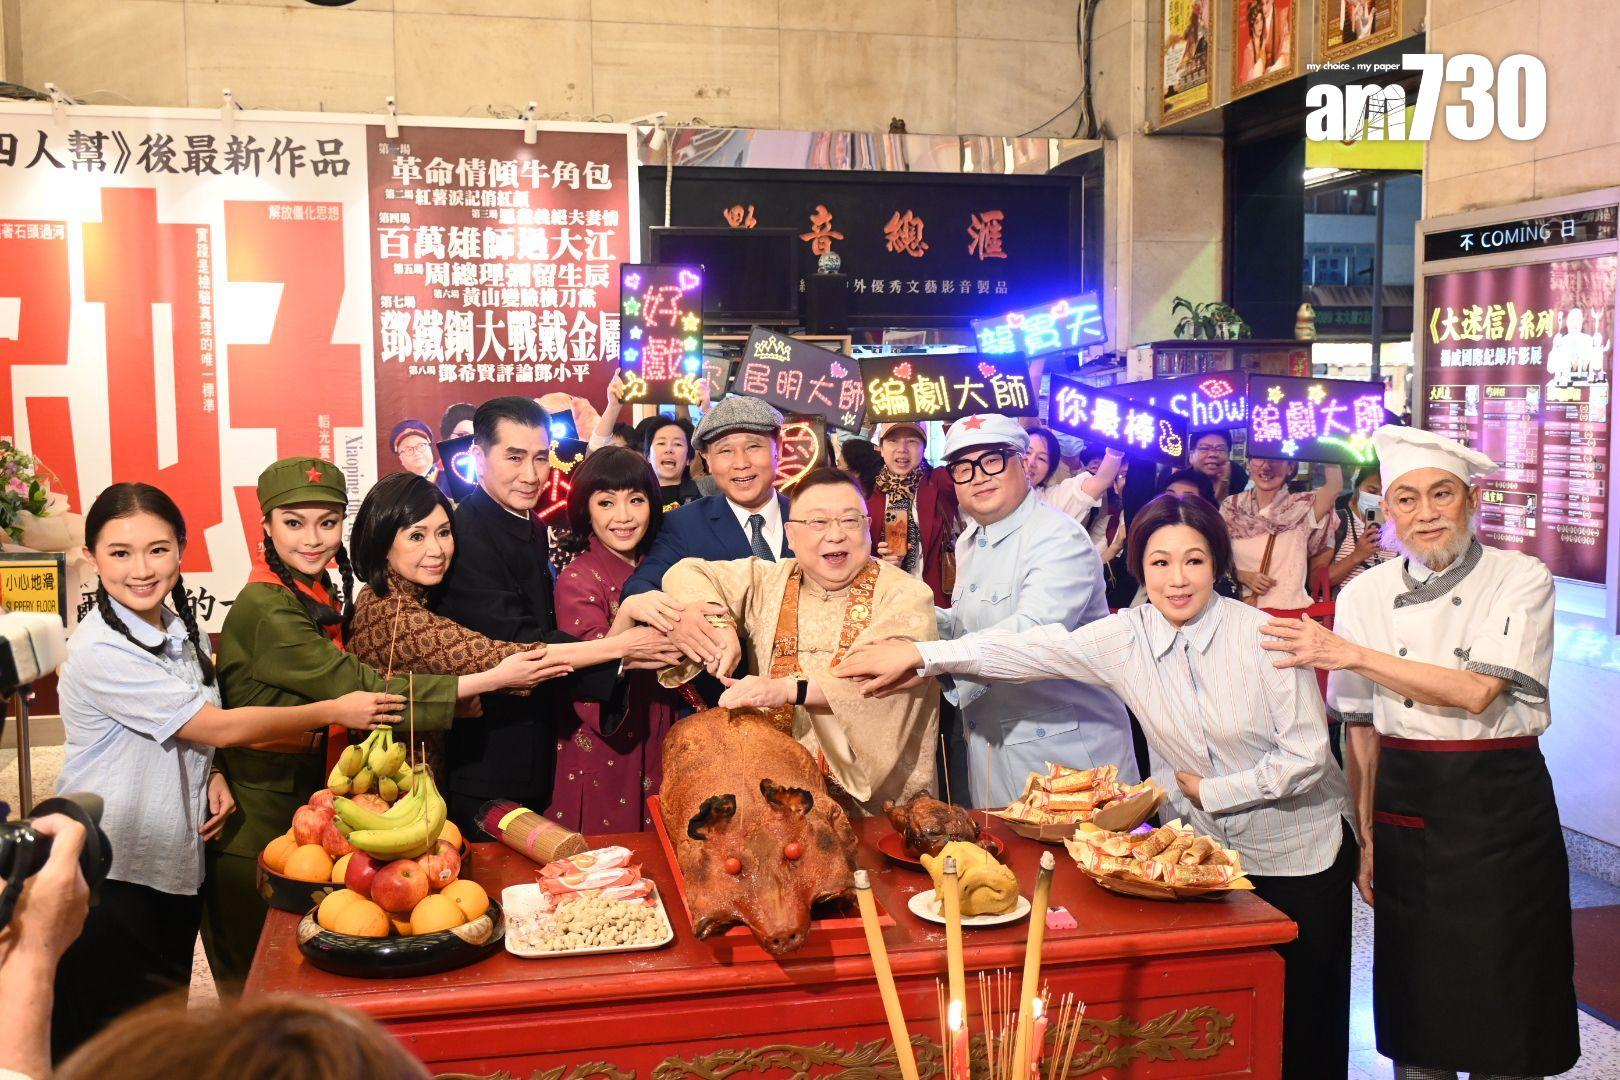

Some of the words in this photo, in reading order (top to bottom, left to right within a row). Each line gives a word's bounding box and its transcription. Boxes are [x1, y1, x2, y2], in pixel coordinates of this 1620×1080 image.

[391, 156, 613, 190] 革命情傾牛角包
[1460, 233, 1474, 251] 不
[1481, 224, 1551, 248] COMING
[1561, 219, 1575, 238] 日
[868, 373, 1029, 415] 編劇大師
[6, 572, 54, 592] 小心地滑
[36, 600, 56, 613] FLOOR
